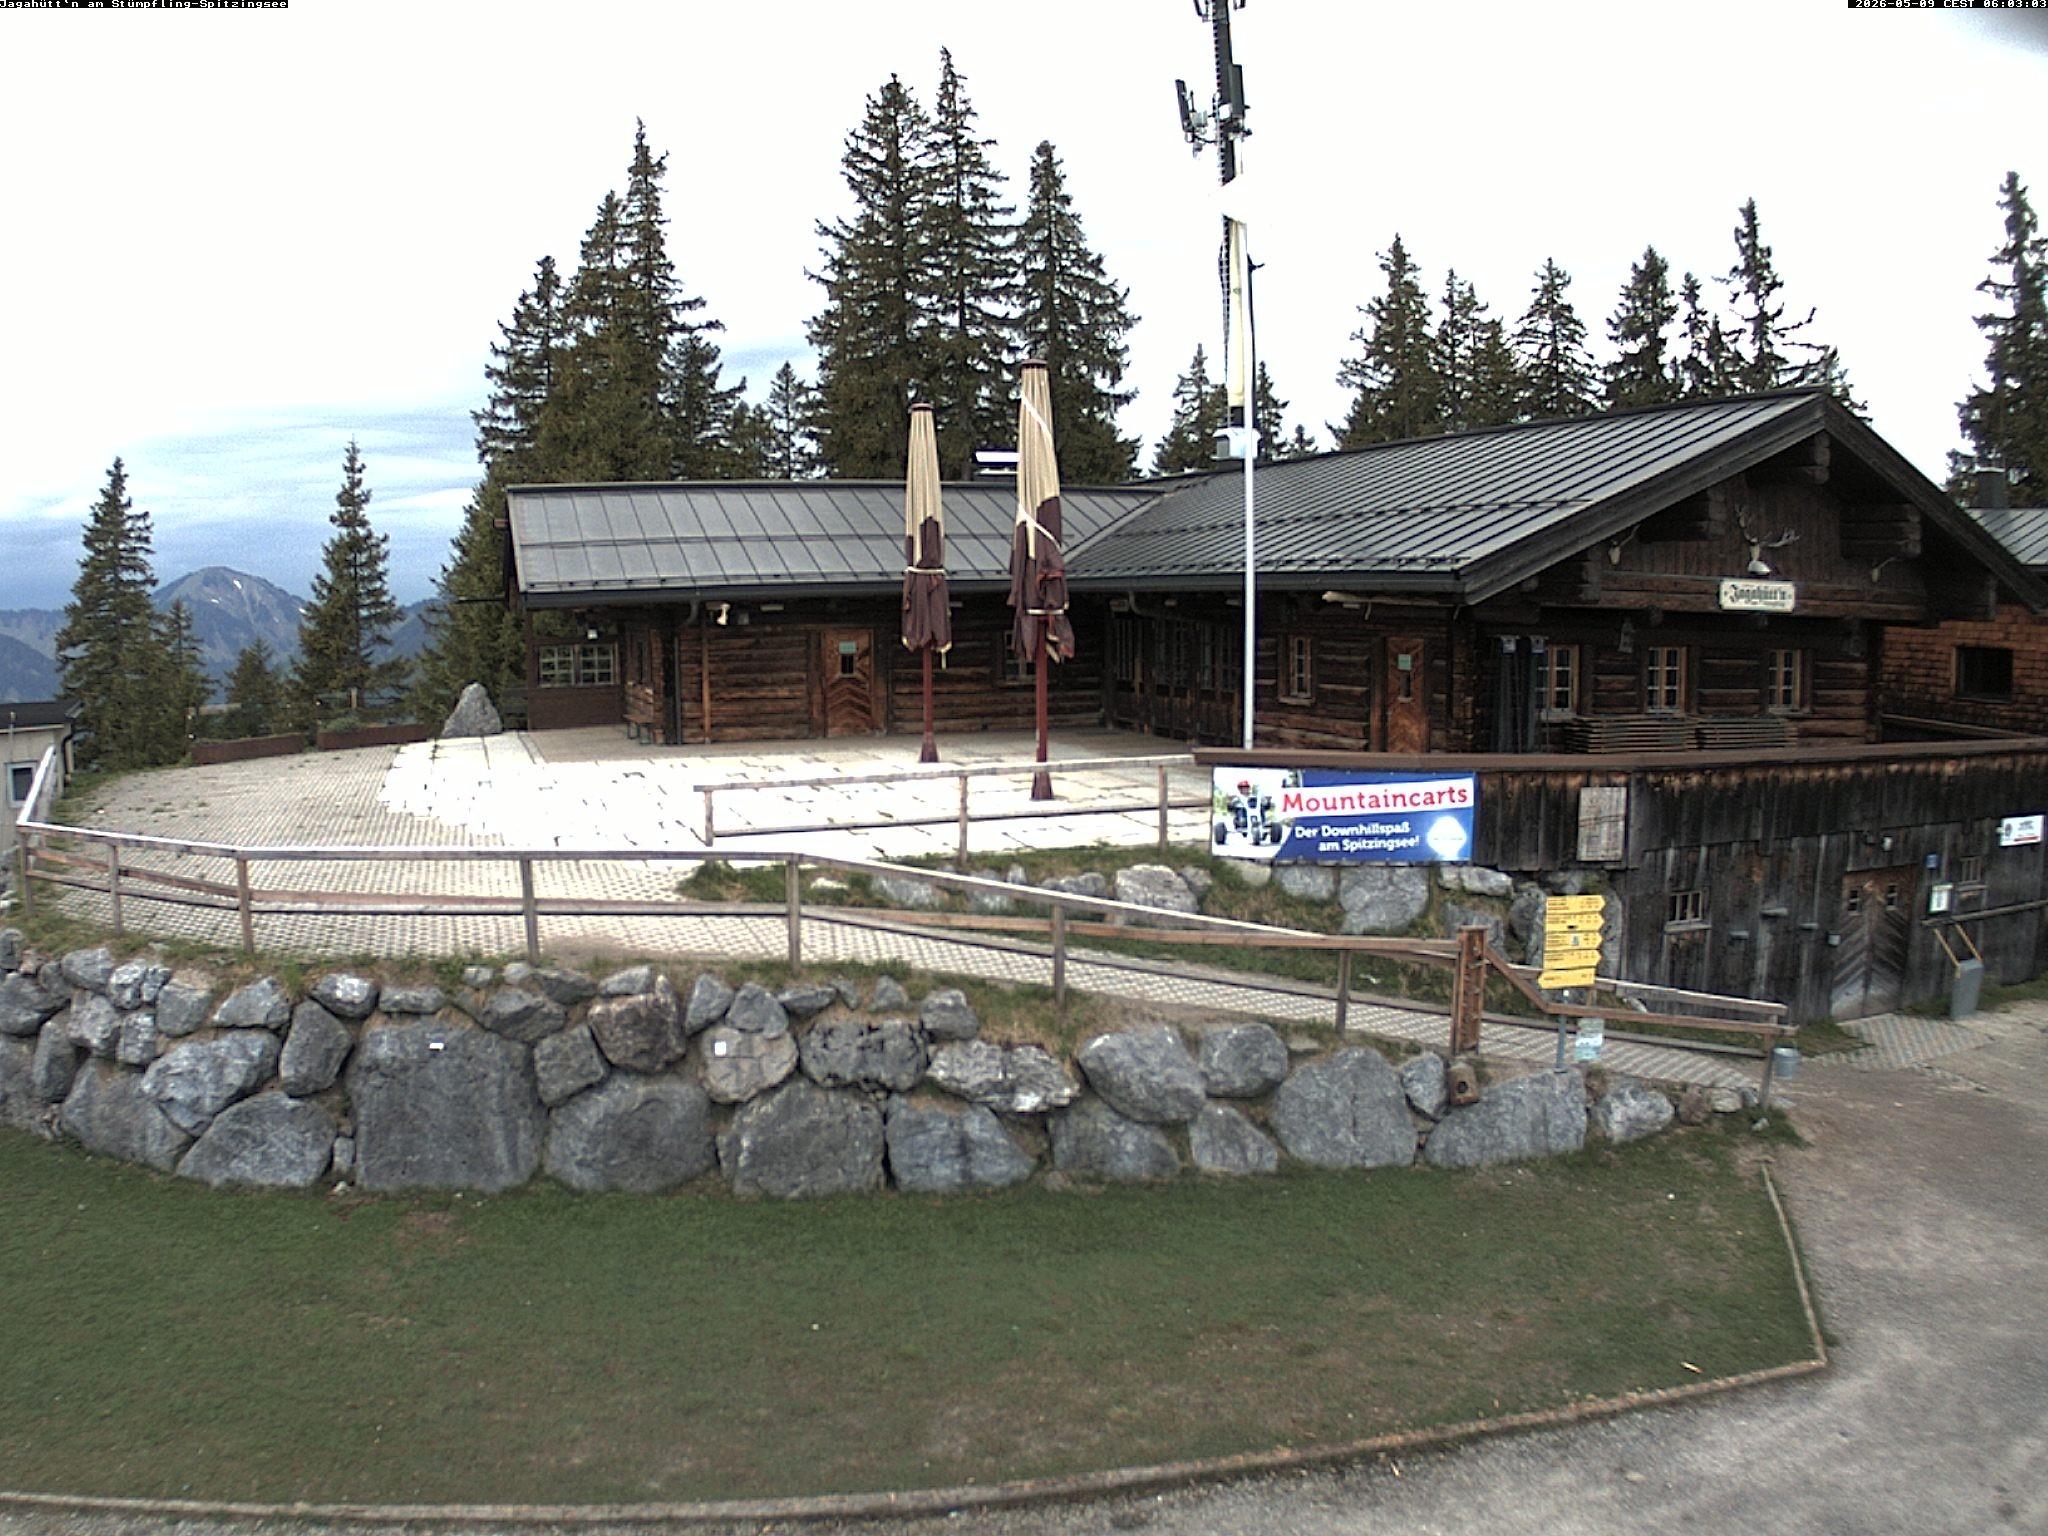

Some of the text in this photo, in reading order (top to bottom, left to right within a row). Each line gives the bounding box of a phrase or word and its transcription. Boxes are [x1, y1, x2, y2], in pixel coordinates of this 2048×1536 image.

[1282, 786, 1468, 812] Mountaincarts
[1295, 822, 1411, 839] Der Downhillspaß
[1318, 836, 1419, 852] am Spitzingsee!
